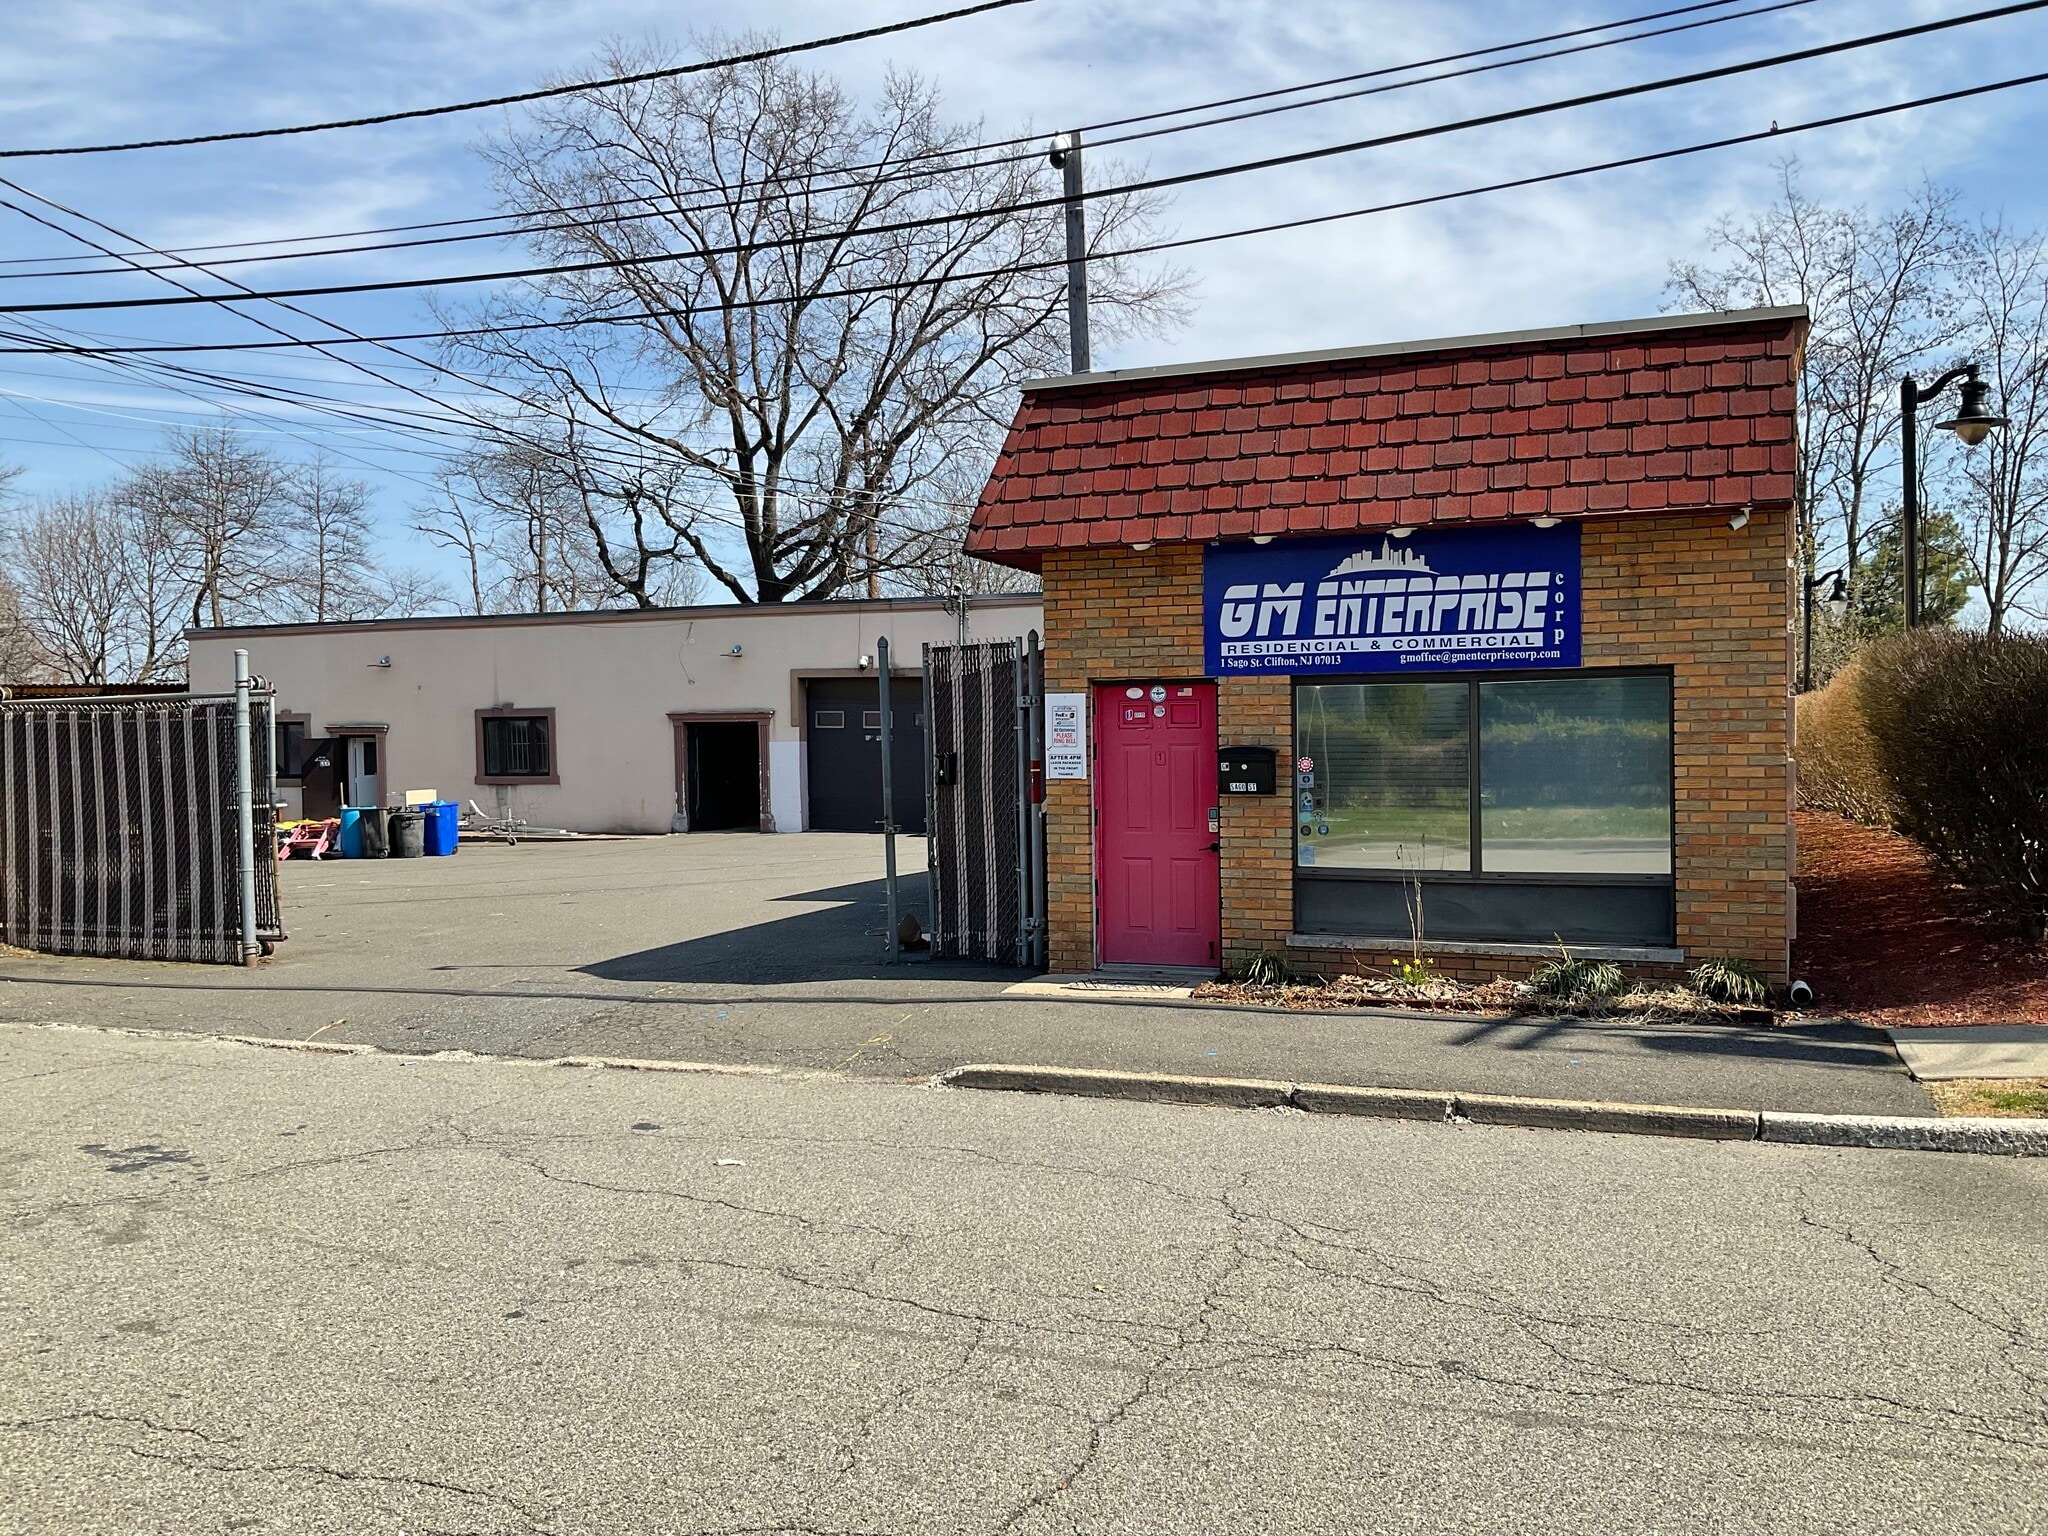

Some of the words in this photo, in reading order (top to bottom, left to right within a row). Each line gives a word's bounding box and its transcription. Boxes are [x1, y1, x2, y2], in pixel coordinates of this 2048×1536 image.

[1219, 582, 1305, 638] GM
[1314, 571, 1551, 636] ENTERPRISE
[1554, 572, 1565, 645] corp
[1227, 641, 1360, 655] RESIDENCIAL
[1370, 640, 1381, 650] &
[1392, 635, 1535, 650] COMMERCIAL
[1227, 658, 1249, 669] Sago
[1250, 658, 1263, 668] St.
[1264, 656, 1298, 667] Clifton,
[1300, 656, 1313, 666] NJ
[1314, 655, 1342, 666] 07013
[1400, 650, 1561, 664] gmoffice@gmenterprisecorp.com
[1230, 783, 1246, 791] SAGO
[1248, 783, 1257, 791] ST
